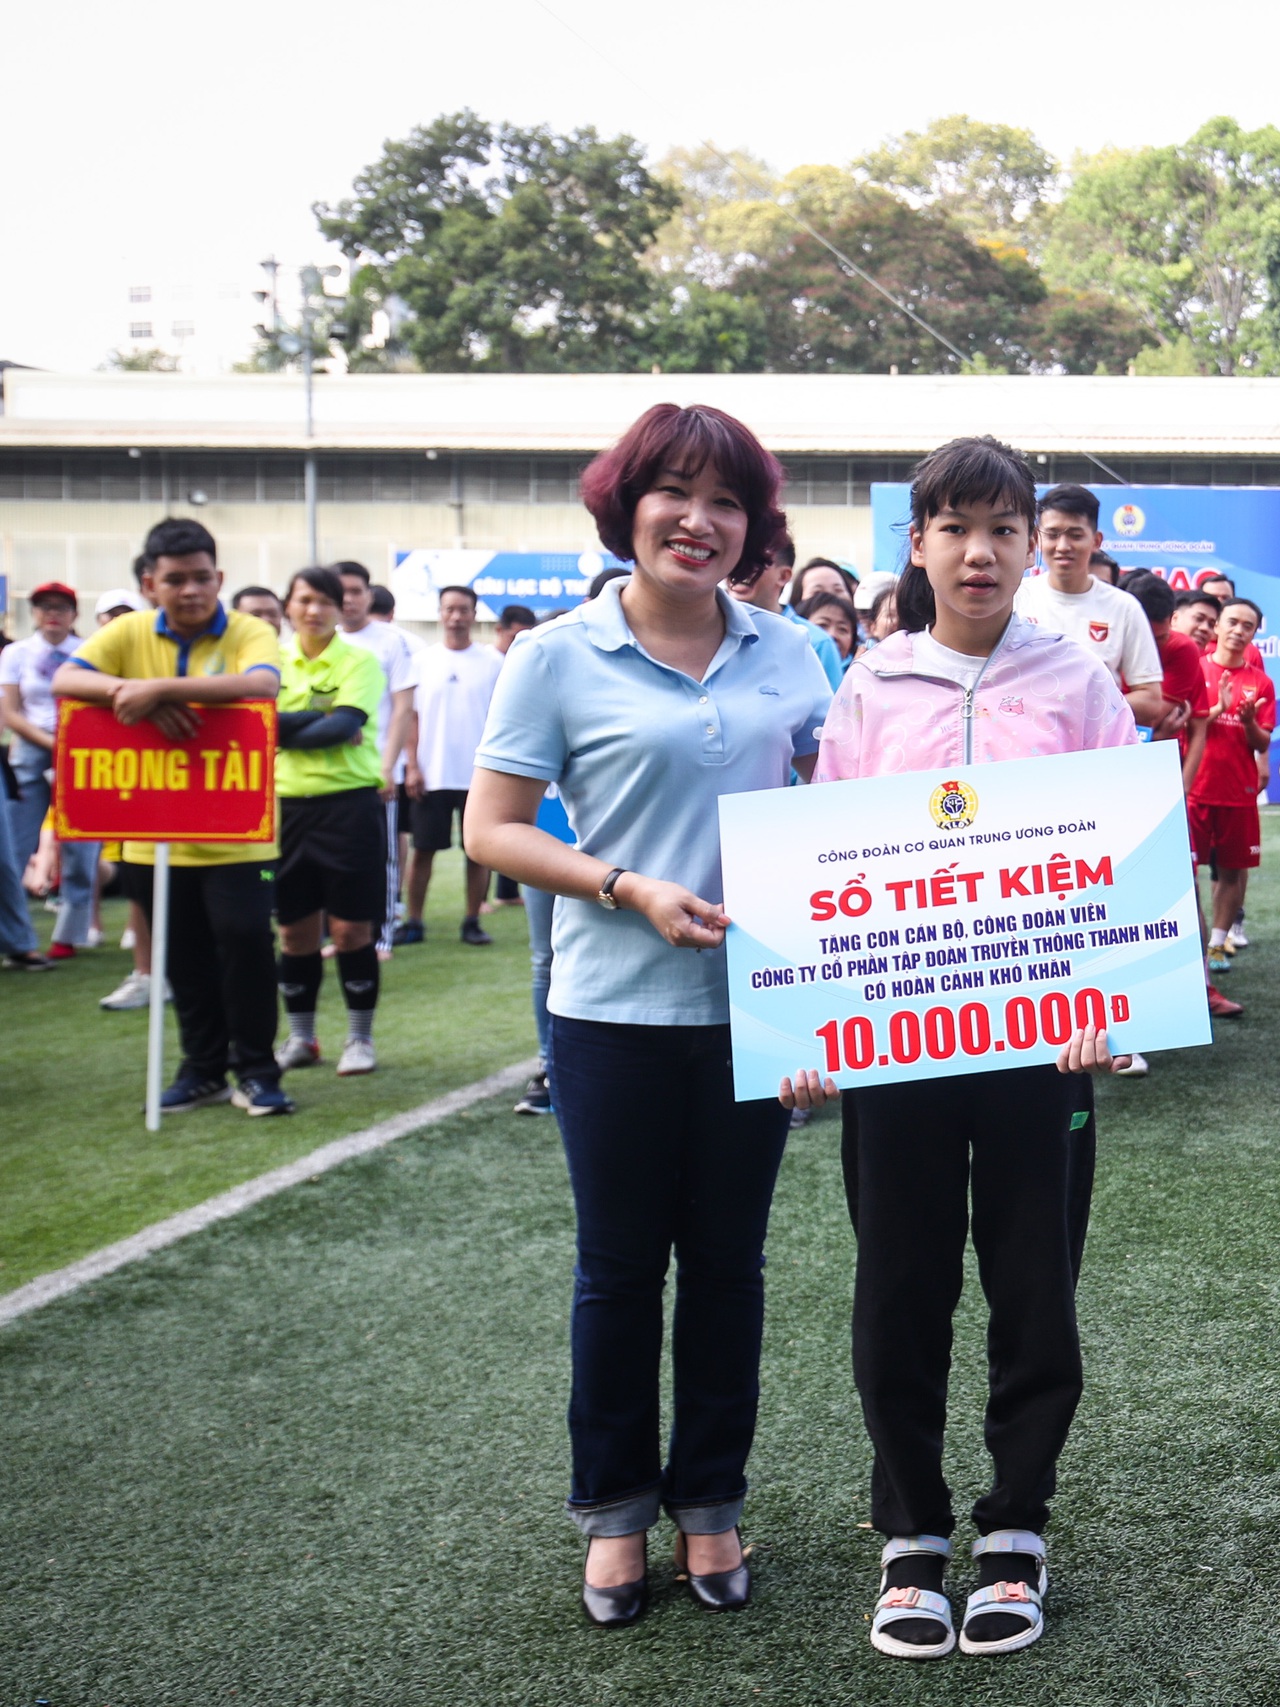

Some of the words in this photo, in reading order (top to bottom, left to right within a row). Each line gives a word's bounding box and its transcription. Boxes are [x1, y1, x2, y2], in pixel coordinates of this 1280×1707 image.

[70, 748, 188, 800] TRỌNG
[201, 741, 261, 791] TÀI
[818, 850, 858, 863] CÔNG
[862, 845, 900, 858] ĐOÀN
[904, 842, 925, 853] CƠ
[929, 837, 965, 850] QUAN
[969, 831, 1011, 845] TRUNG
[1015, 826, 1054, 840] ƯƠNG
[1058, 820, 1096, 834] ĐOÀN
[809, 872, 873, 922] SỔ
[885, 862, 985, 912] TIẾT
[999, 852, 1114, 901] KIỆM
[752, 968, 794, 989] CÔNG
[798, 965, 816, 983] TY
[821, 955, 843, 980] CỔ
[847, 953, 888, 977] PHẦN
[891, 951, 921, 973] TẬP
[925, 947, 967, 968] ĐOÀN
[971, 939, 1029, 962] TRUYỀN
[1032, 932, 1085, 954] THÔNG
[1088, 925, 1140, 947] THANH
[1144, 920, 1179, 941] NIÊN
[819, 934, 861, 956] TẶNG
[867, 929, 900, 949] CON
[905, 925, 937, 945] CÁN
[942, 921, 968, 941] BỘ,
[973, 915, 1017, 936] CÔNG
[1022, 909, 1066, 930] ĐOÀN
[1070, 904, 1106, 924] VIÊN
[864, 982, 886, 1001] CÓ
[892, 977, 935, 998] HOÀN
[940, 970, 984, 992] CẢNH
[989, 965, 1022, 986] KHÓ
[1027, 960, 1071, 981] KHĂN
